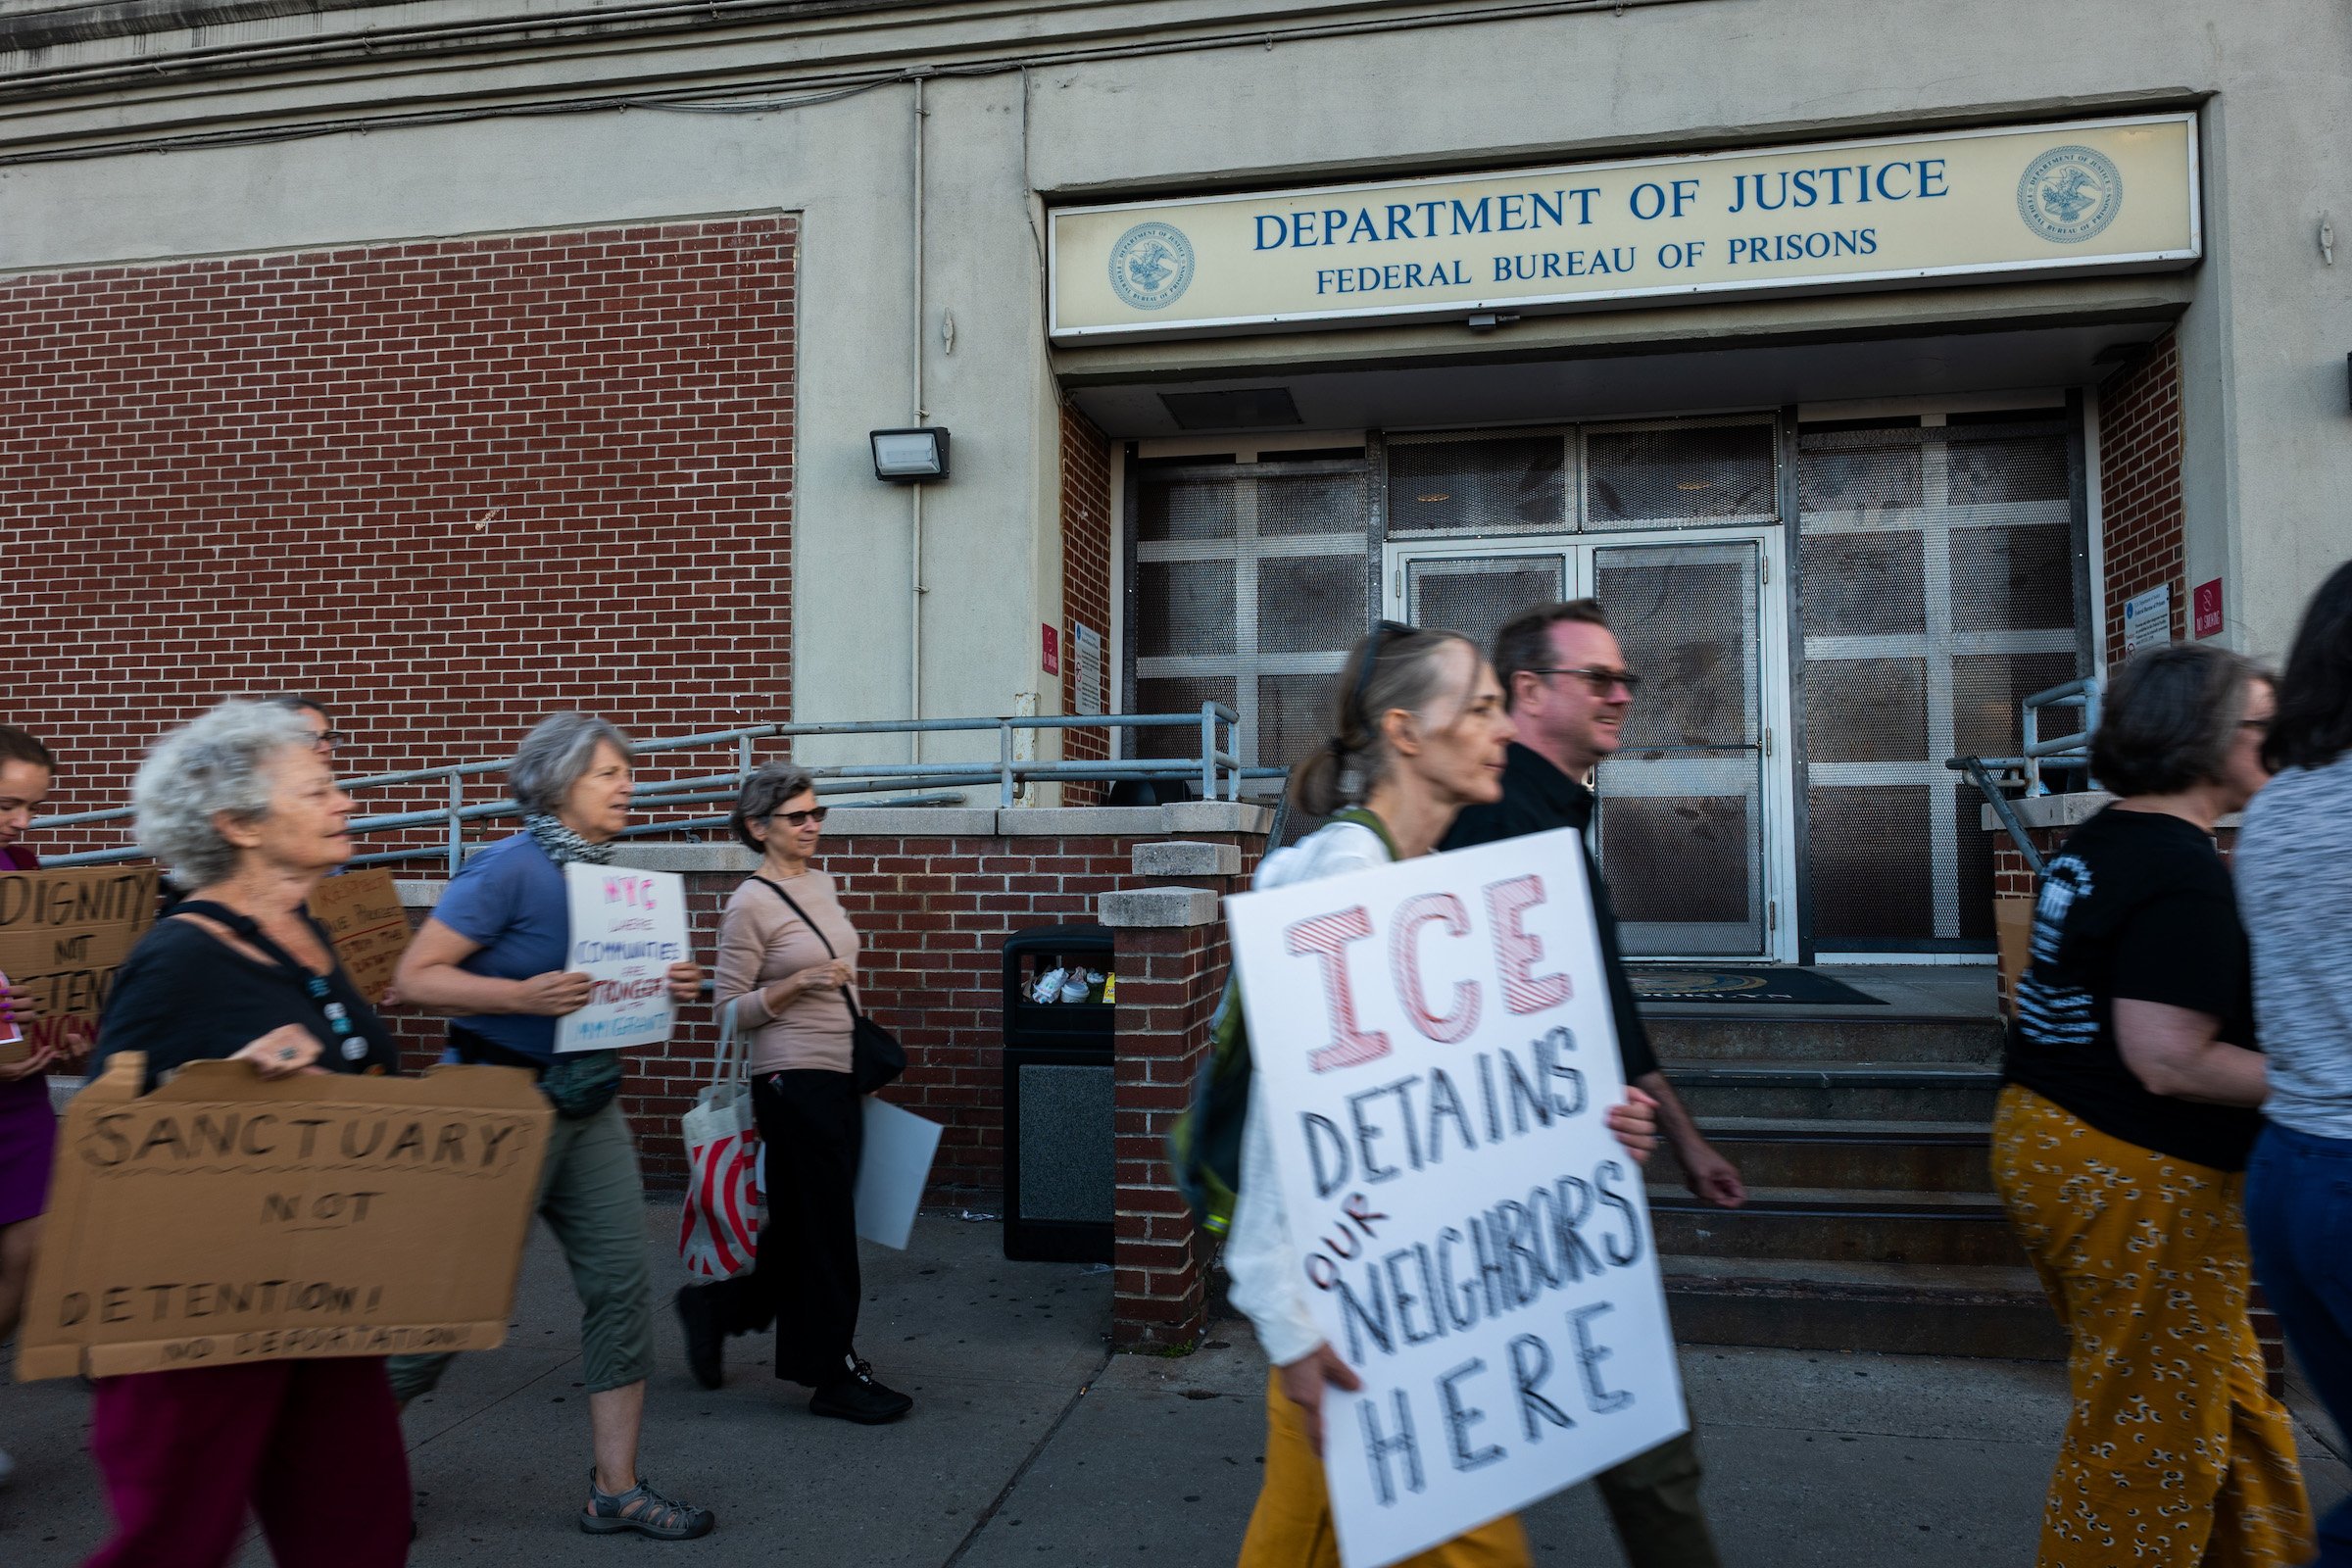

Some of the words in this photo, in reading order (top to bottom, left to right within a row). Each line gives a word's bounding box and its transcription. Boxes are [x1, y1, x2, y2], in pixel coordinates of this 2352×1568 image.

[1253, 187, 1600, 252] DEPARTMENT
[1630, 178, 1699, 220] OF
[1728, 159, 1949, 216] JUSTICE
[1316, 260, 1471, 295] FEDERAL
[1492, 246, 1638, 283] BUREAU
[1657, 240, 1705, 270] OF
[1728, 228, 1878, 265] PRISONS
[0, 871, 154, 932] DIGNITY
[54, 934, 96, 965] NOT
[1283, 873, 1573, 1074] ICE
[77, 1112, 514, 1169] SANCTUARY
[1298, 1025, 1588, 1201] DETAINS
[260, 1191, 385, 1225] NOT
[1303, 1191, 1390, 1292] OUR
[1335, 1159, 1643, 1367] NEIGHBORS
[60, 1279, 383, 1328] DETENTION!
[1355, 1299, 1636, 1509] HERE
